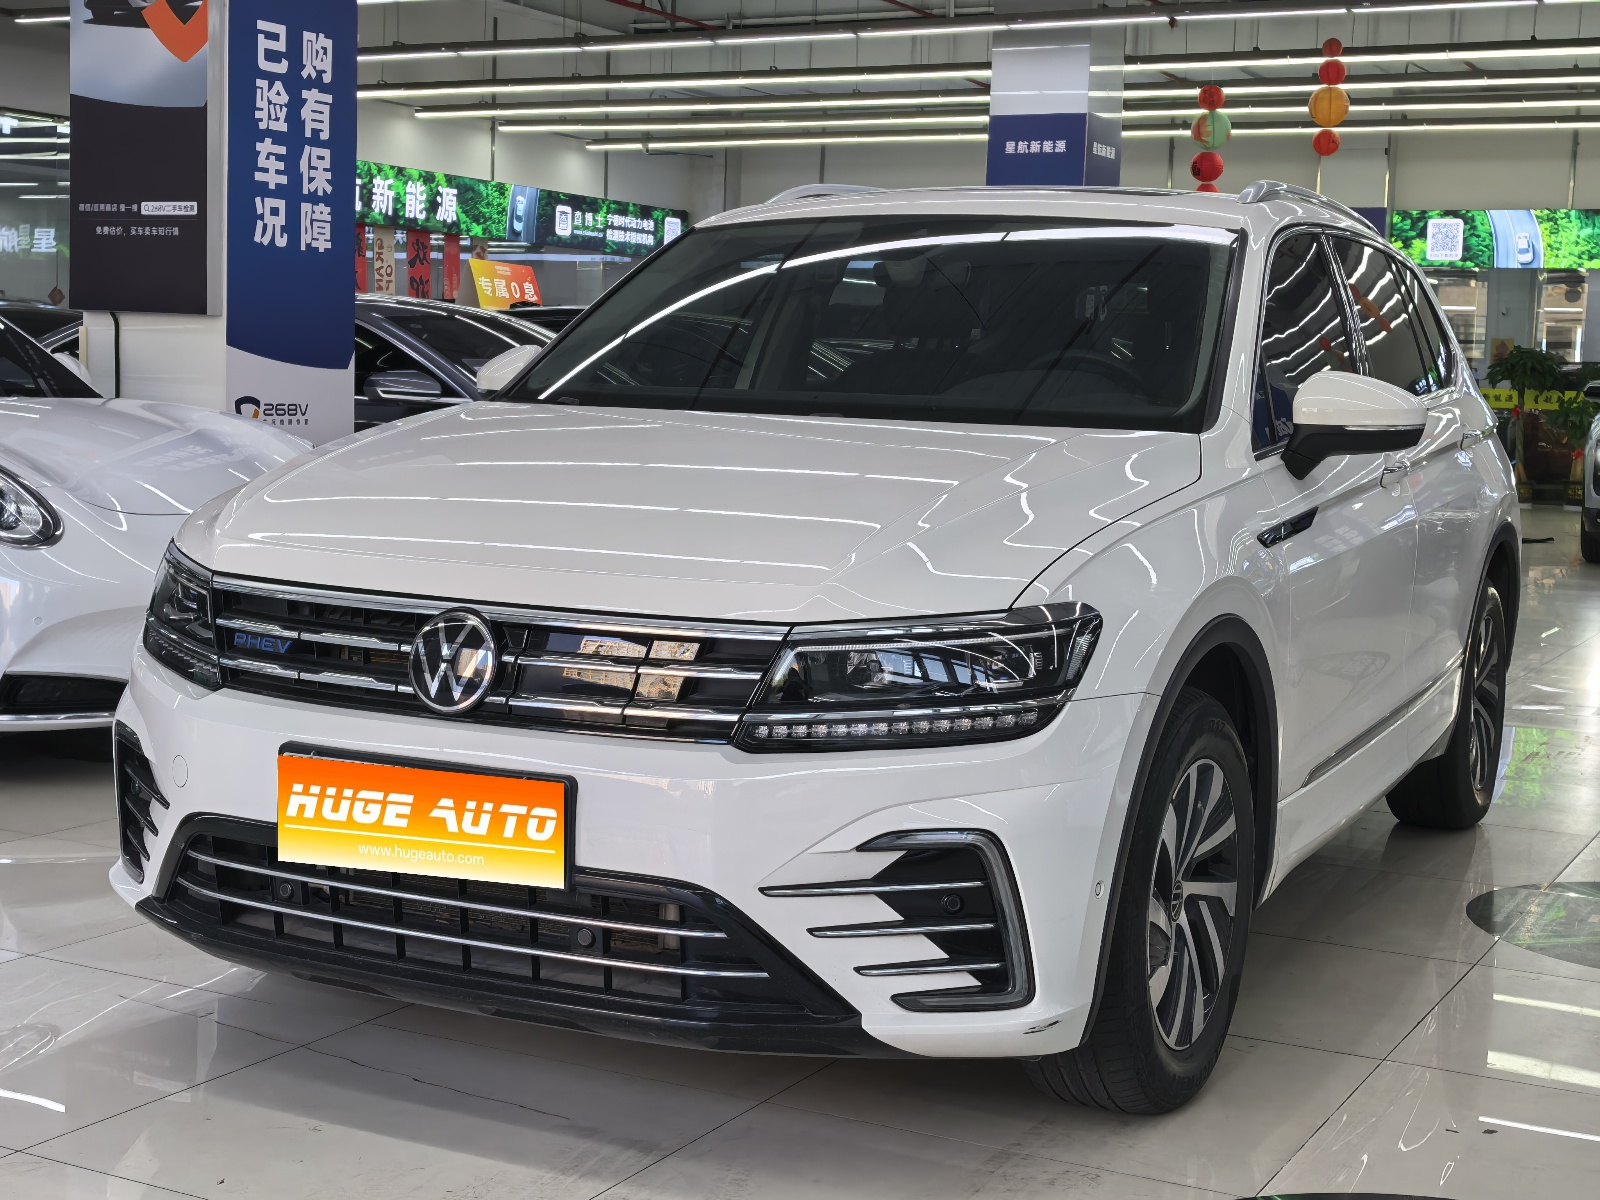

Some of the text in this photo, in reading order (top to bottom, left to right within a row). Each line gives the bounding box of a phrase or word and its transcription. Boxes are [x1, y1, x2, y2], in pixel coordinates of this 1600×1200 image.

[254, 20, 289, 248] 已验车况
[301, 31, 333, 253] 购有保障
[1005, 140, 1067, 154] 星航新能源
[263, 403, 308, 416] 268V
[234, 632, 293, 653] PHEV
